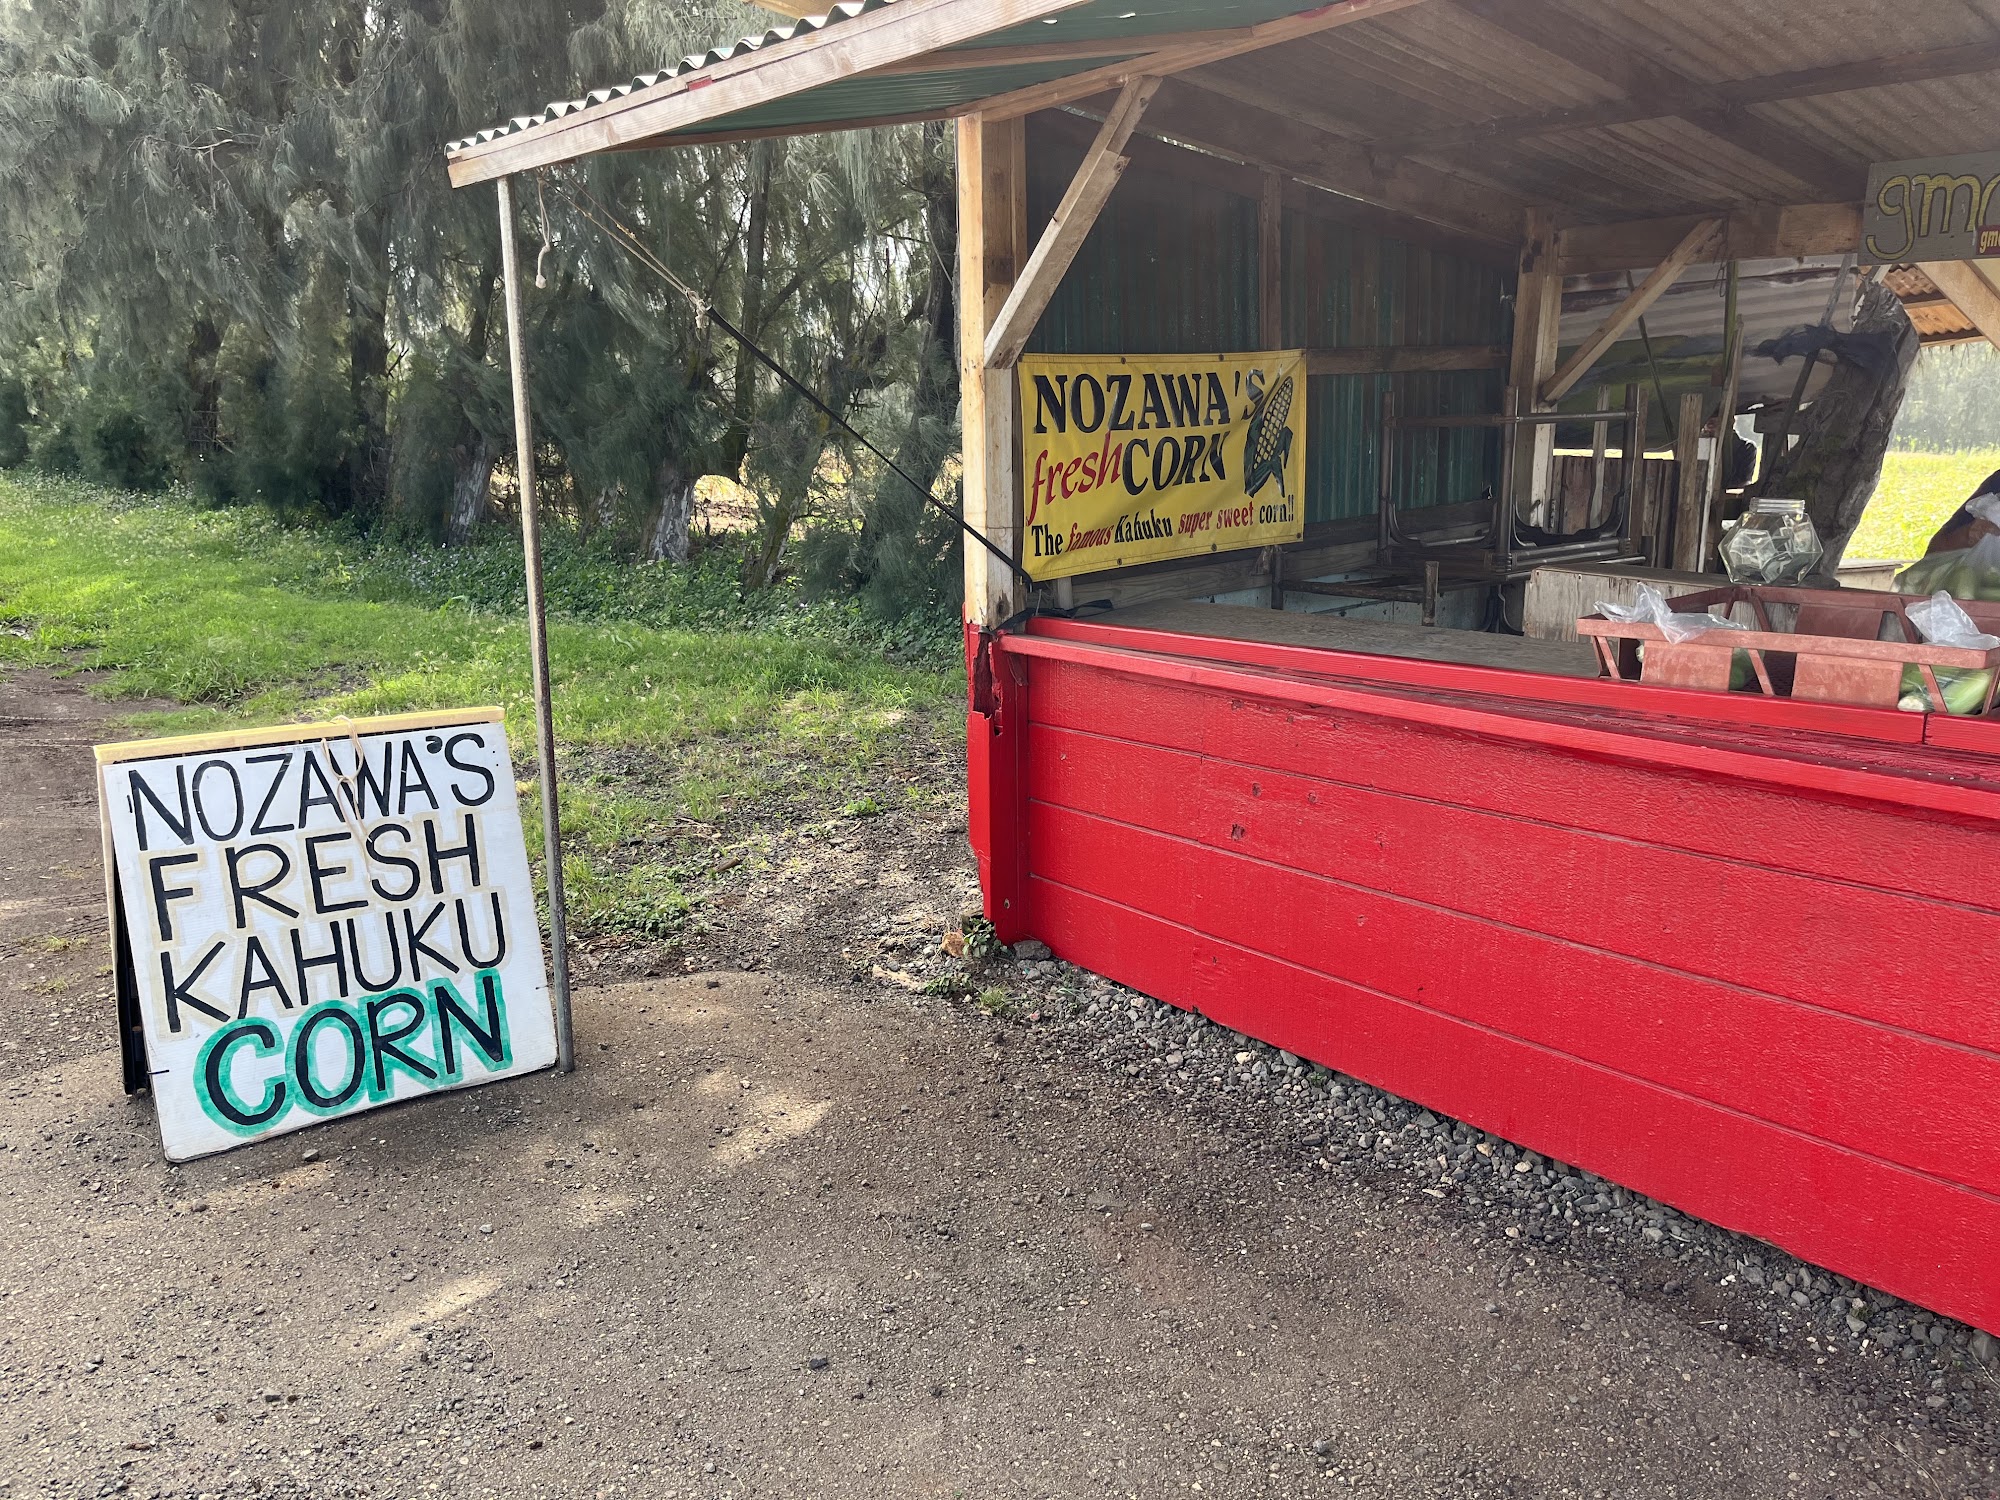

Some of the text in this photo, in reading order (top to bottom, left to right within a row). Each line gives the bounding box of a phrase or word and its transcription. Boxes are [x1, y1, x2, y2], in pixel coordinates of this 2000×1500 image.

[1980, 230, 2000, 254] gm
[1032, 369, 1266, 433] NOZAWA'S
[1026, 430, 1230, 526] fresh CORN
[1031, 494, 1295, 557] The famous Kahuku super sweet corn!!
[128, 733, 495, 850] NOZAWA'S
[149, 814, 481, 941] FRESH
[160, 891, 506, 1033] KAHUKU
[194, 968, 513, 1135] CORN
